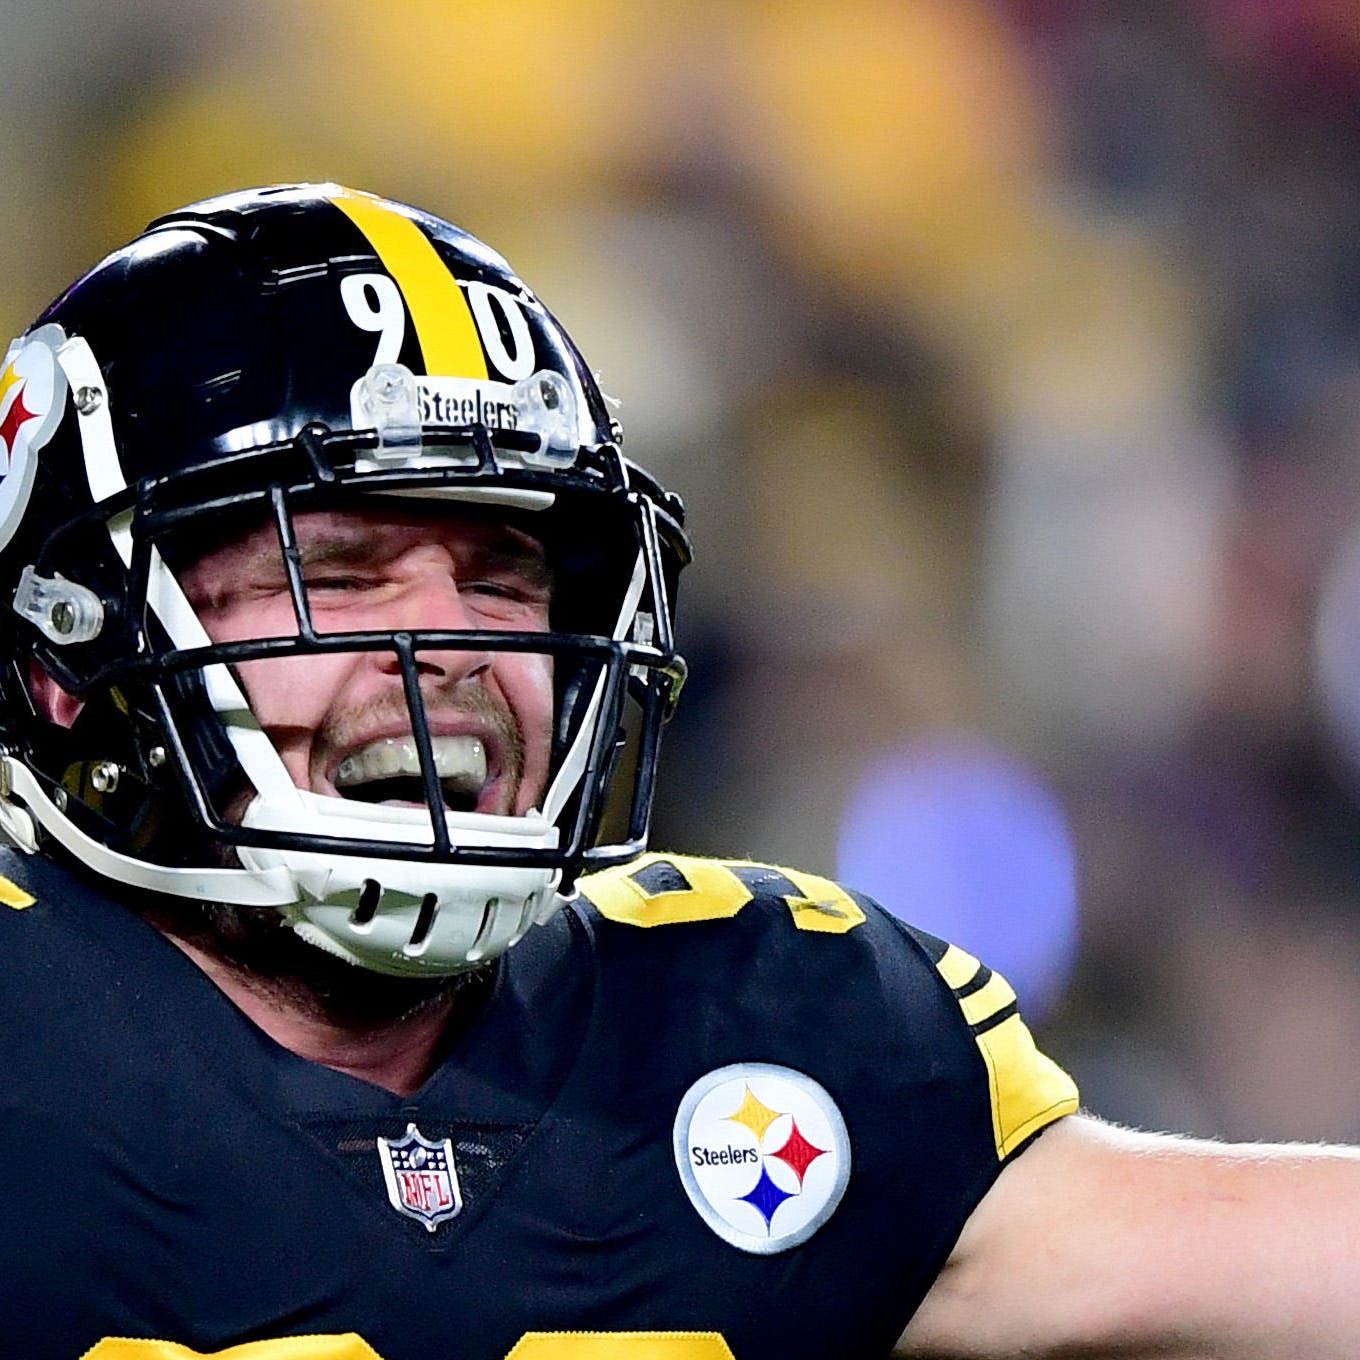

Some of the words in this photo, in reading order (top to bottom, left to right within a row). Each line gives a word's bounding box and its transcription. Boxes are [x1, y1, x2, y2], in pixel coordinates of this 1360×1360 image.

[417, 386, 518, 430] Steelers
[692, 1144, 759, 1166] Steelers
[401, 1173, 450, 1211] NFL
